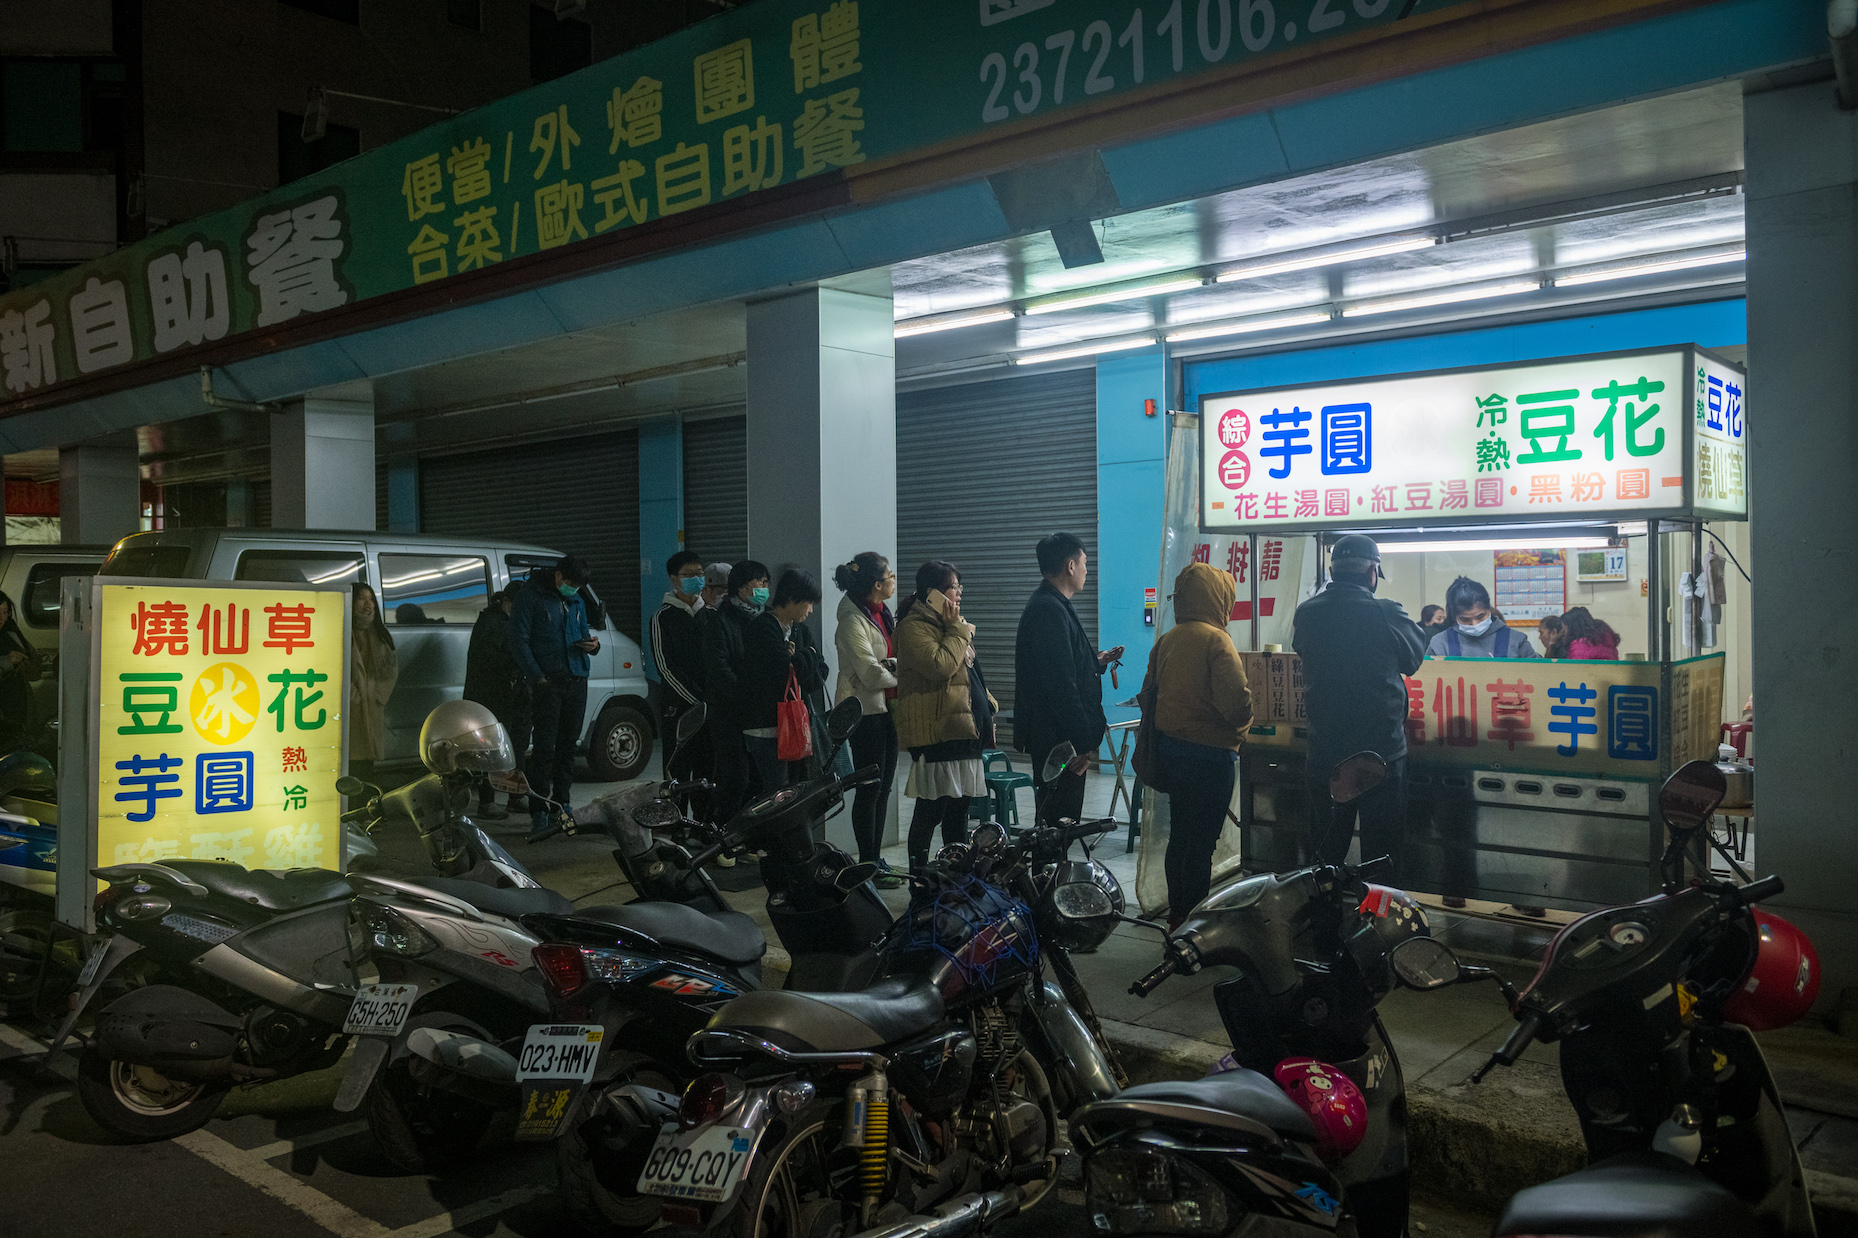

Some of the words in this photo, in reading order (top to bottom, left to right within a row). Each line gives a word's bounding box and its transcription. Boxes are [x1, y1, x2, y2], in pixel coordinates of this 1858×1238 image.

[0, 195, 347, 392] 新自助餐
[1516, 377, 1666, 466] 豆花
[1707, 375, 1741, 437] 豆花
[1220, 411, 1249, 488] 綜合
[1259, 402, 1372, 479] 芋圓
[1696, 441, 1743, 504] 燒仙草
[1610, 556, 1623, 570] 17
[131, 600, 315, 656] 燒仙草
[1271, 658, 1285, 718] 綠豆豆花
[1547, 681, 1658, 761] 芋圓
[114, 750, 254, 823] 芋圓
